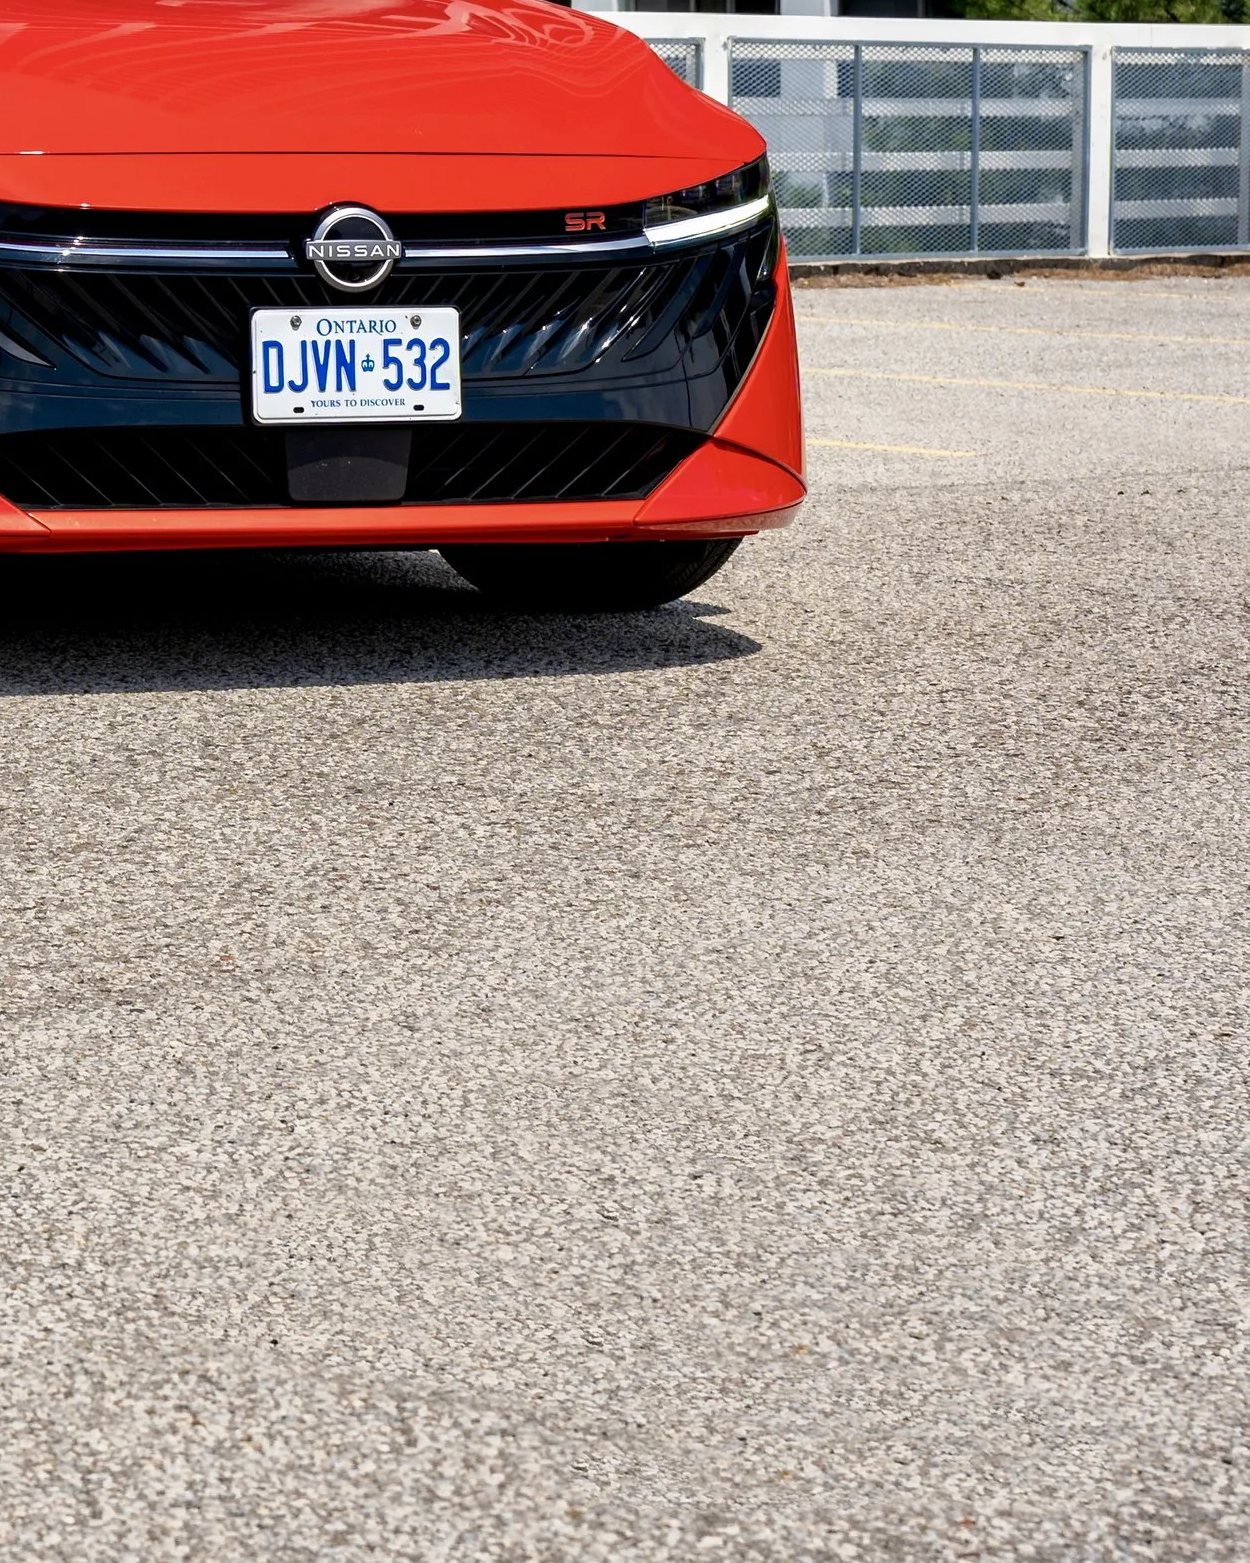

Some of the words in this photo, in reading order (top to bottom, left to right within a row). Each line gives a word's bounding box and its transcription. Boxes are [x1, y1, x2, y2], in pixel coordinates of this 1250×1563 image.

[565, 211, 606, 231] SR
[309, 244, 400, 257] NISSAN
[316, 318, 397, 336] ONTARIO
[262, 339, 356, 393] DJVN
[382, 338, 450, 391] 532
[311, 399, 341, 408] YOURS
[344, 399, 358, 407] TO
[360, 398, 406, 407] DISCOVER
